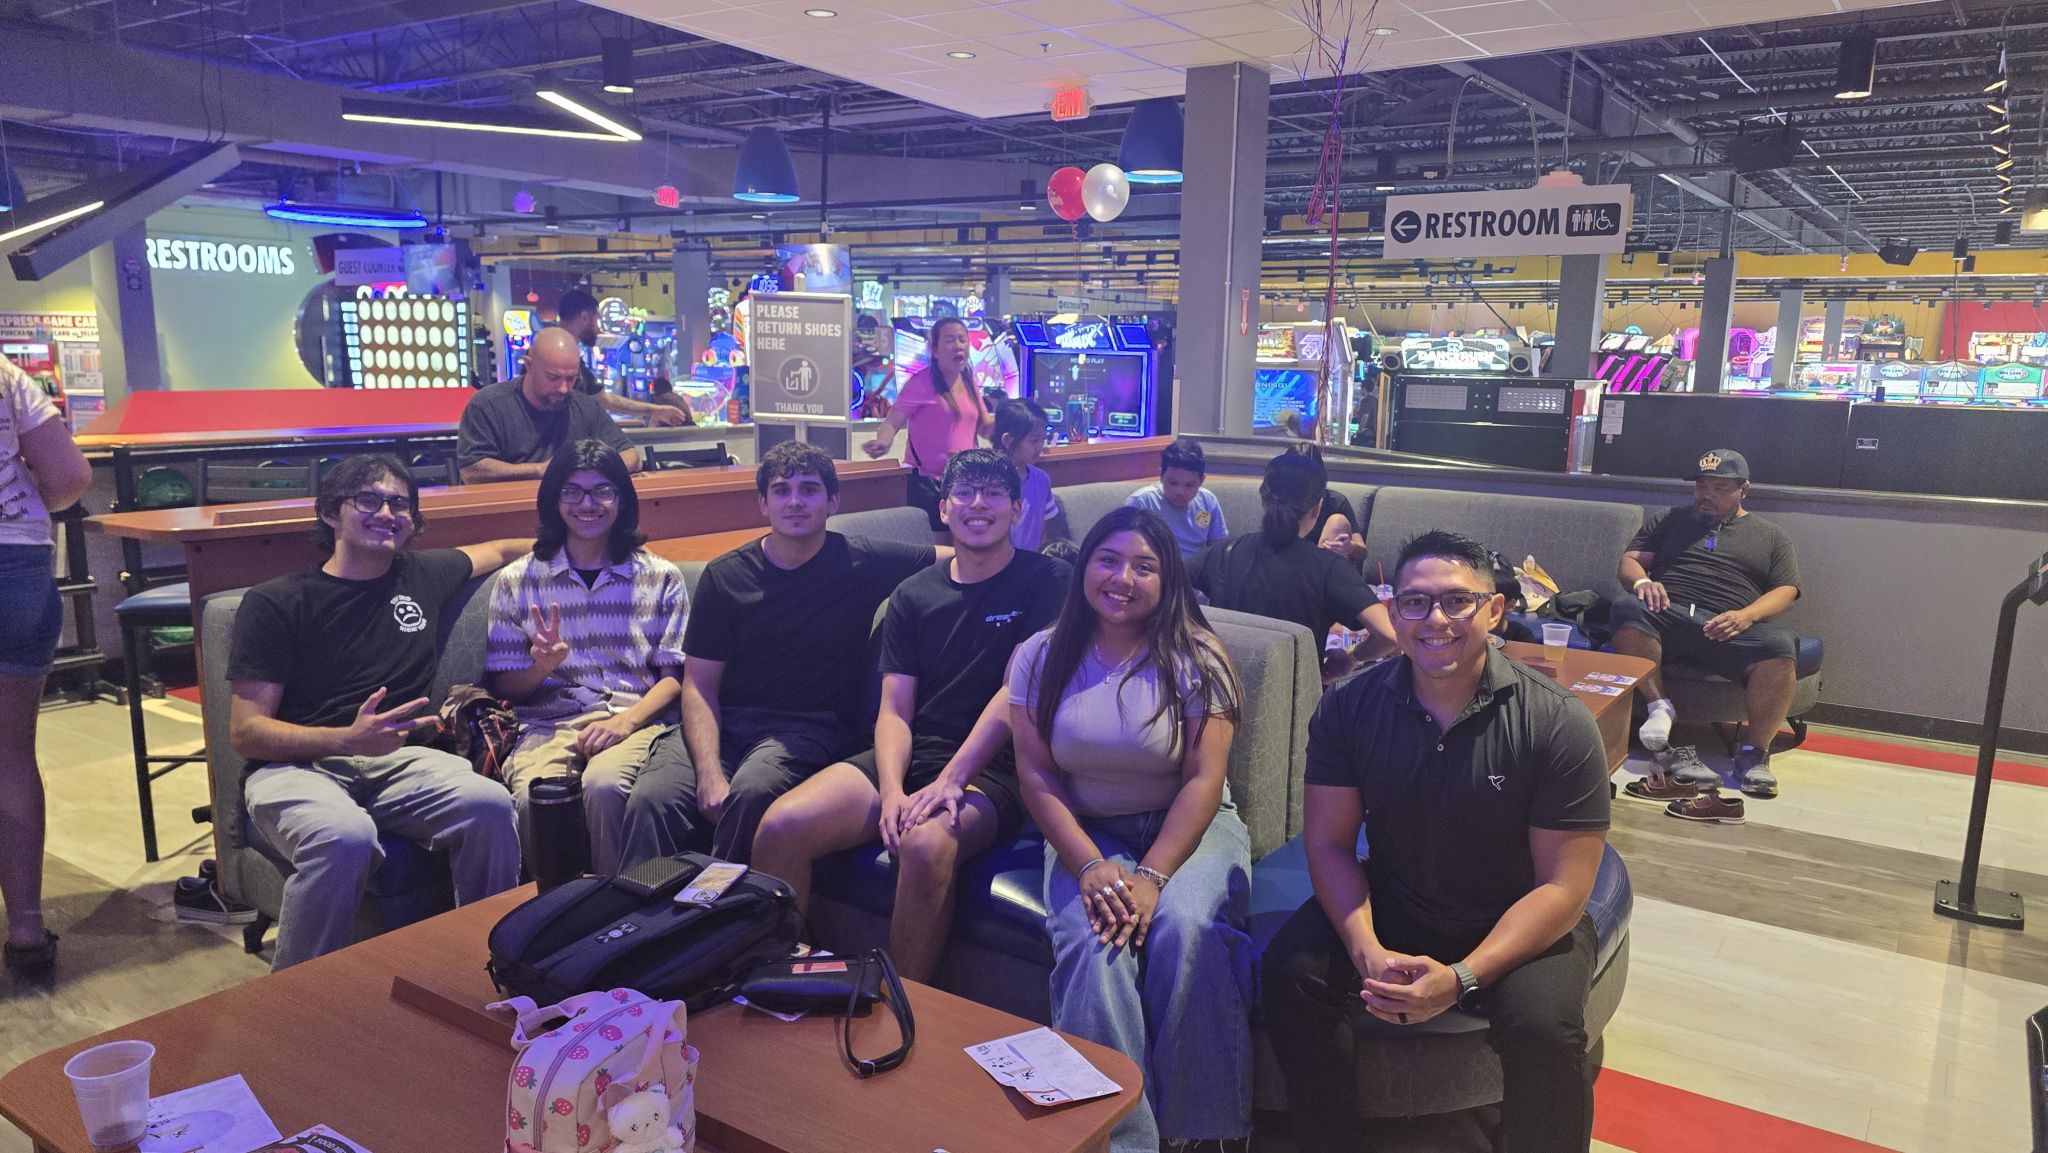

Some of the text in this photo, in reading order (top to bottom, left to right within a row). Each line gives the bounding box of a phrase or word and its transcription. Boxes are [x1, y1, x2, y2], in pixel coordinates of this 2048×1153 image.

[1425, 208, 1560, 239] RESTROOM
[145, 238, 295, 275] RESTROOMS
[756, 304, 800, 319] PLEASE
[756, 321, 842, 337] RETURN SHOES
[756, 337, 786, 351] HERE
[774, 402, 824, 414] THANK YOU
[314, 1137, 336, 1149] FOOD
